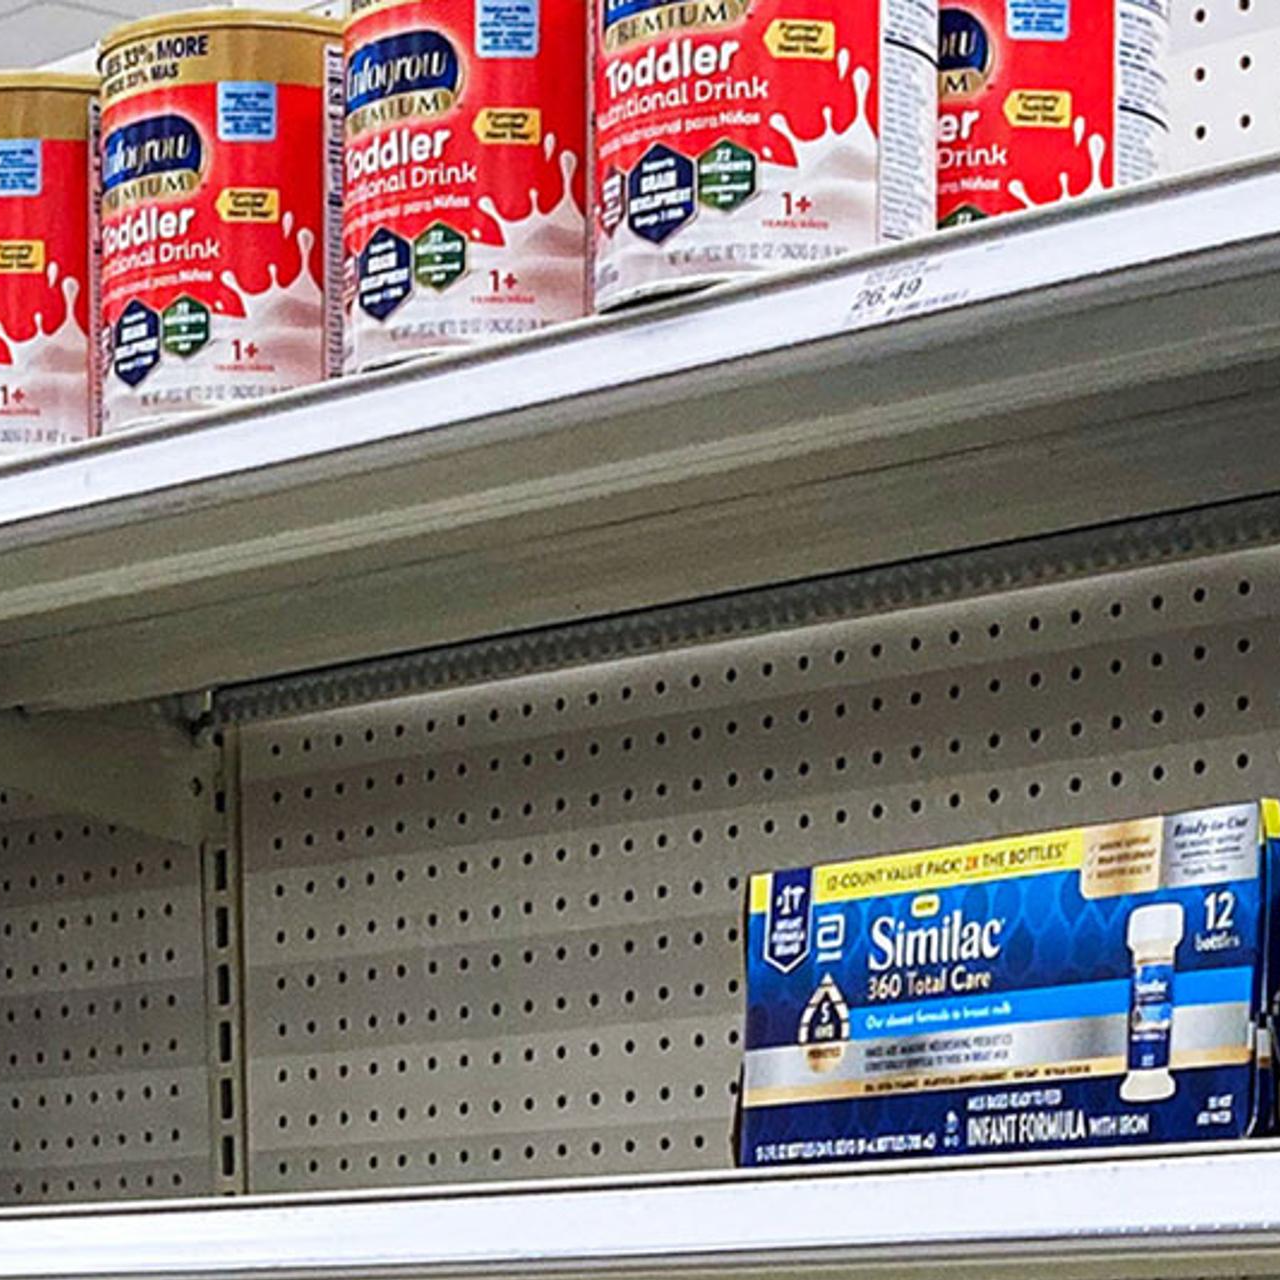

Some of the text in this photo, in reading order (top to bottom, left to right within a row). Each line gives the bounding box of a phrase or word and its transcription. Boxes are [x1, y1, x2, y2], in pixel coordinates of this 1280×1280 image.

[156, 35, 209, 58] MORE
[606, 39, 740, 99] Toddler
[695, 76, 769, 102] Drink
[938, 144, 1007, 168] Drink
[411, 161, 477, 185] Drink
[781, 192, 812, 216] 1+
[160, 238, 220, 260] Drink
[489, 270, 517, 292] 1+
[851, 277, 922, 311] 26.49
[232, 340, 259, 361] 1+
[0, 385, 25, 405] 1+
[982, 854, 1005, 867] THE
[1204, 891, 1235, 930] 12
[869, 910, 1001, 970] Similac
[868, 966, 992, 1000] 360 Total Care
[967, 1114, 1017, 1147] INFANT
[1020, 1110, 1087, 1142] FORMULA
[1119, 1114, 1150, 1134] IRON
